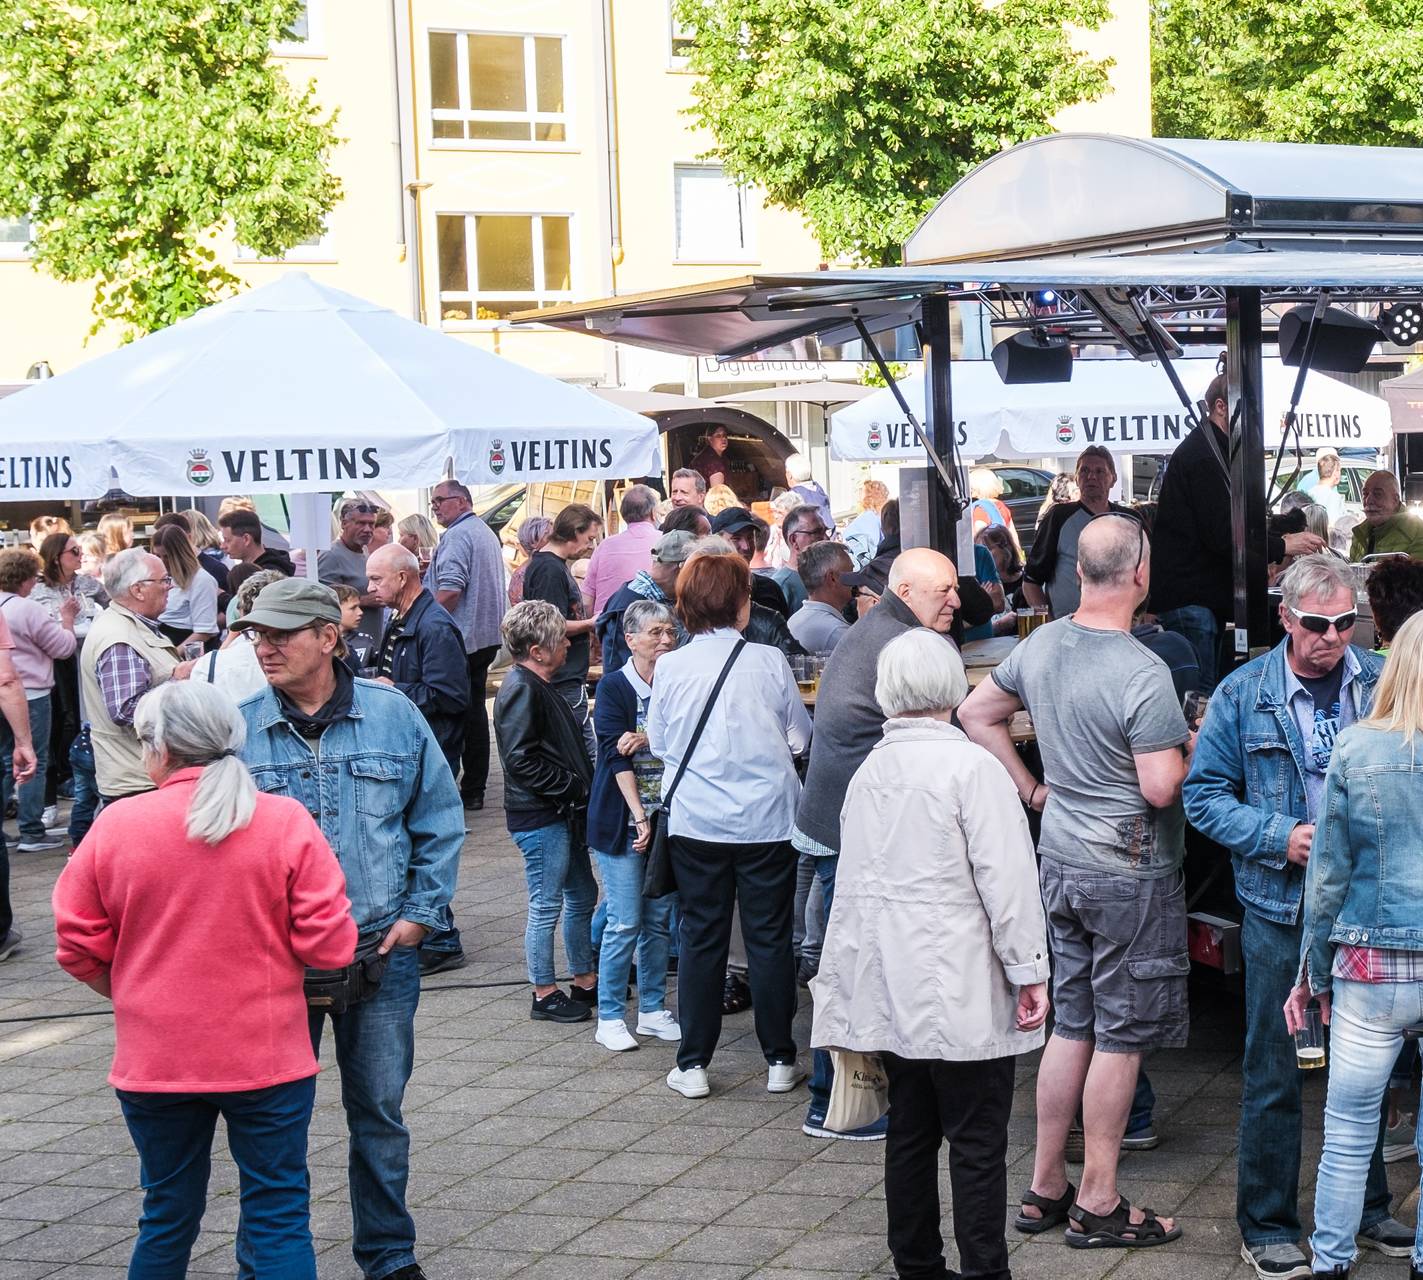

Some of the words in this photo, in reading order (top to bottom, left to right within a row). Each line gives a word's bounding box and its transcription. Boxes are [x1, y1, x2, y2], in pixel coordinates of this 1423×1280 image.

[1295, 413, 1362, 439] VELTINS
[222, 447, 381, 482] VELTINS
[510, 438, 613, 471] VELTINS
[0, 456, 73, 488] ELTINS
